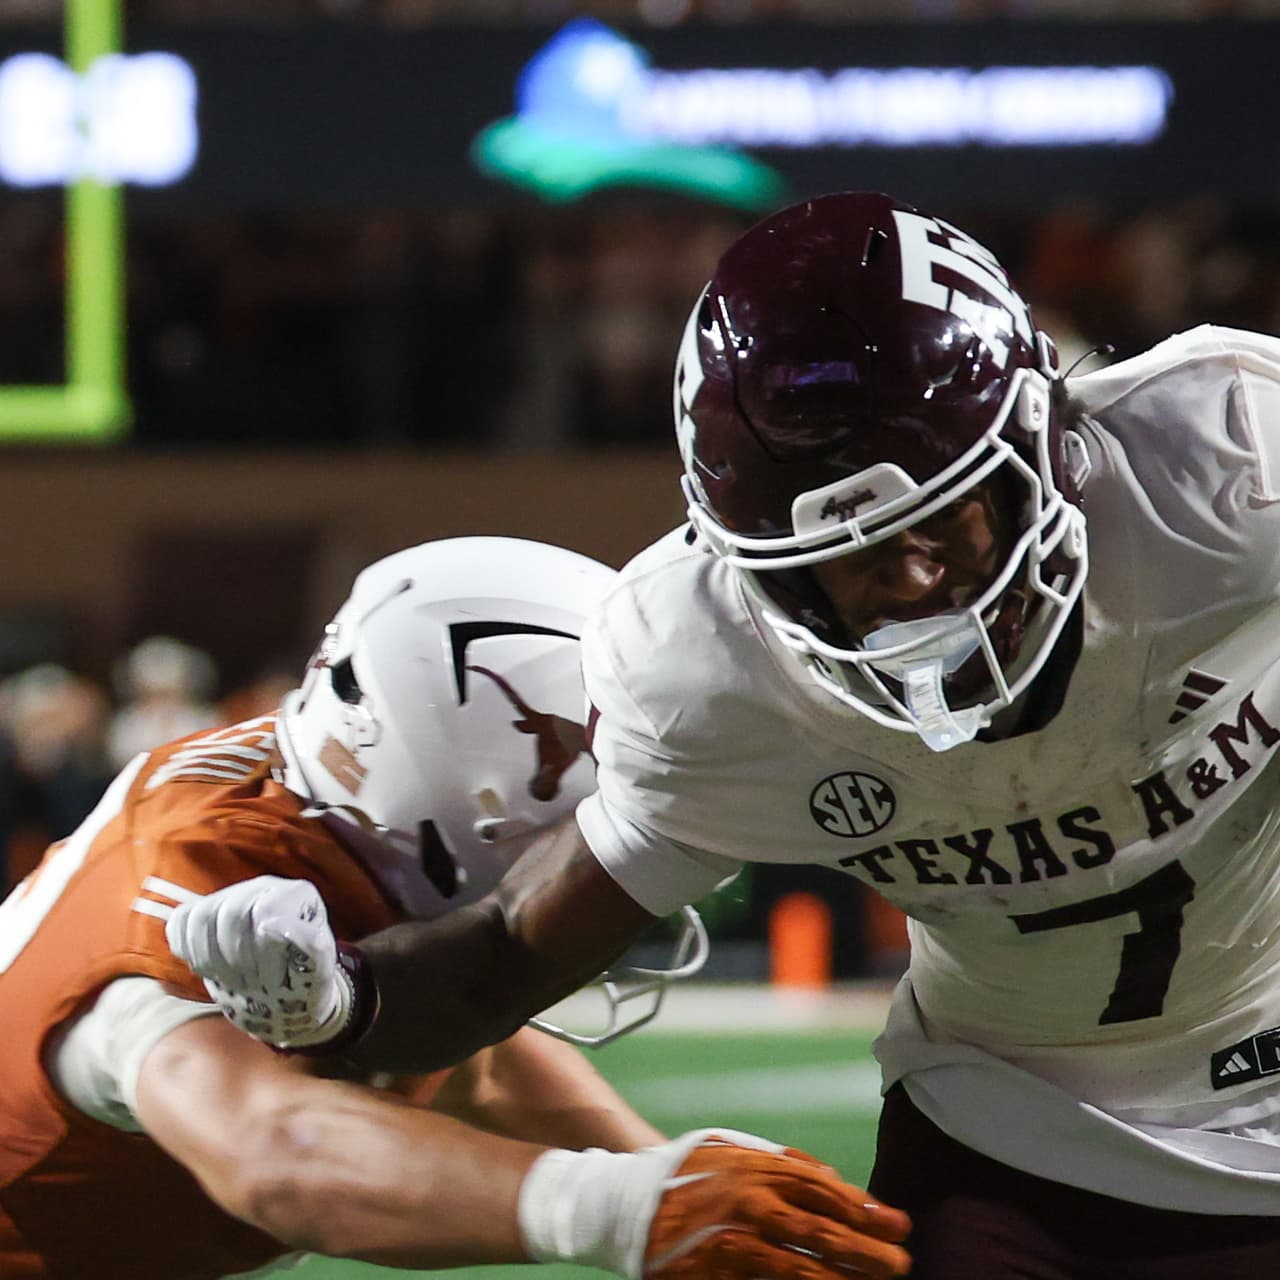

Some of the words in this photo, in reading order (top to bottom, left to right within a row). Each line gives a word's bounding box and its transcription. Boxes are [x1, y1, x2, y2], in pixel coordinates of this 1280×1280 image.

[812, 773, 894, 837] SEC
[838, 806, 1116, 885] TEXAS
[1008, 859, 1196, 1025] 7
